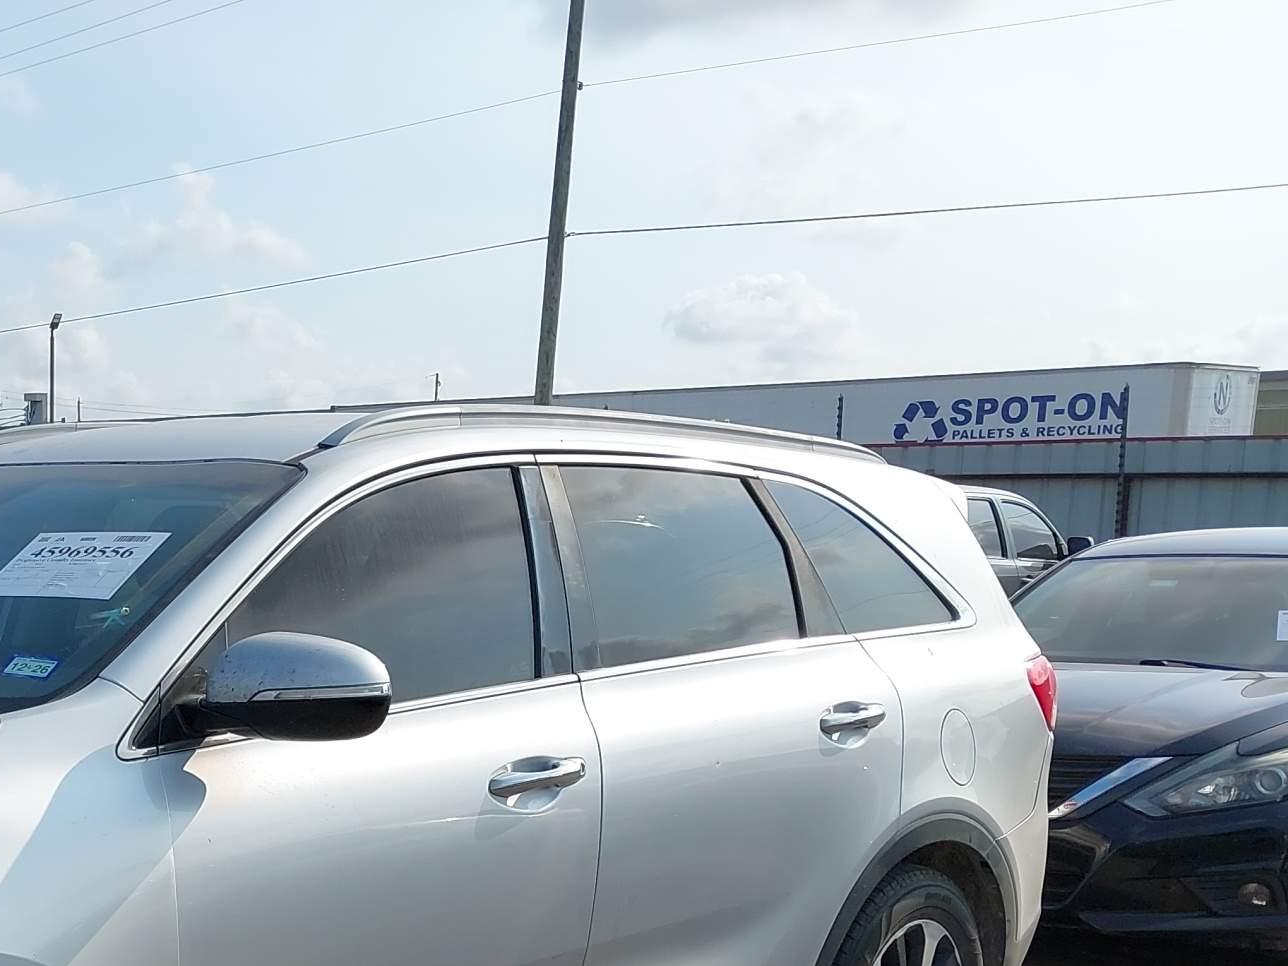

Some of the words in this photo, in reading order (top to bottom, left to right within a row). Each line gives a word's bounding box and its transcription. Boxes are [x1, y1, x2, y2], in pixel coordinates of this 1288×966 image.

[950, 392, 1126, 426] SPOT-ON
[952, 428, 1014, 440] PALLETS
[1020, 427, 1030, 438] &
[1036, 424, 1125, 437] RECYCLING
[30, 545, 139, 558] 45969556
